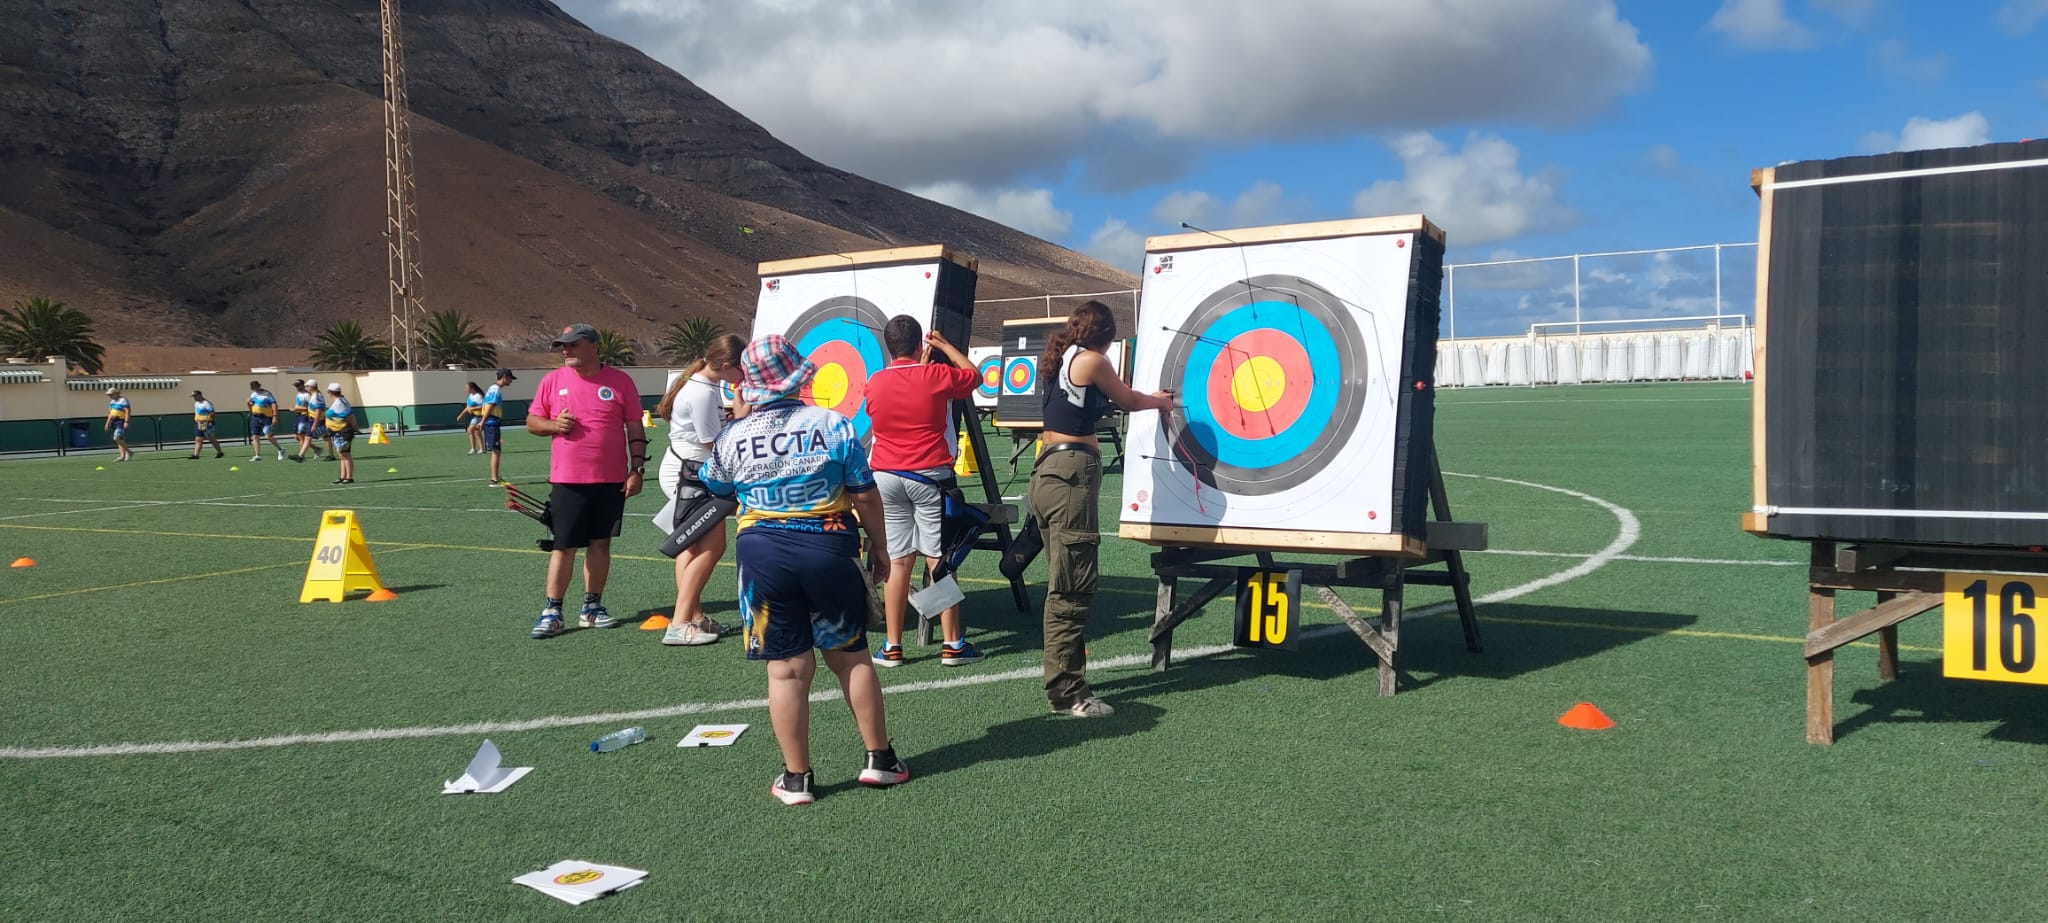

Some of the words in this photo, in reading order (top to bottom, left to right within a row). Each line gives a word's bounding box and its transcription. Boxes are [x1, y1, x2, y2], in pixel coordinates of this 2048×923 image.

[735, 429, 828, 462] FECTA
[743, 460, 791, 472] FDERACION
[758, 471, 778, 480] TIRO
[780, 467, 799, 478] CON
[800, 464, 825, 474] ARCO
[746, 478, 829, 509] JUEZ
[685, 506, 717, 536] EASTON
[317, 545, 343, 565] 40
[1248, 571, 1289, 645] 15
[1964, 579, 2036, 674] 16
